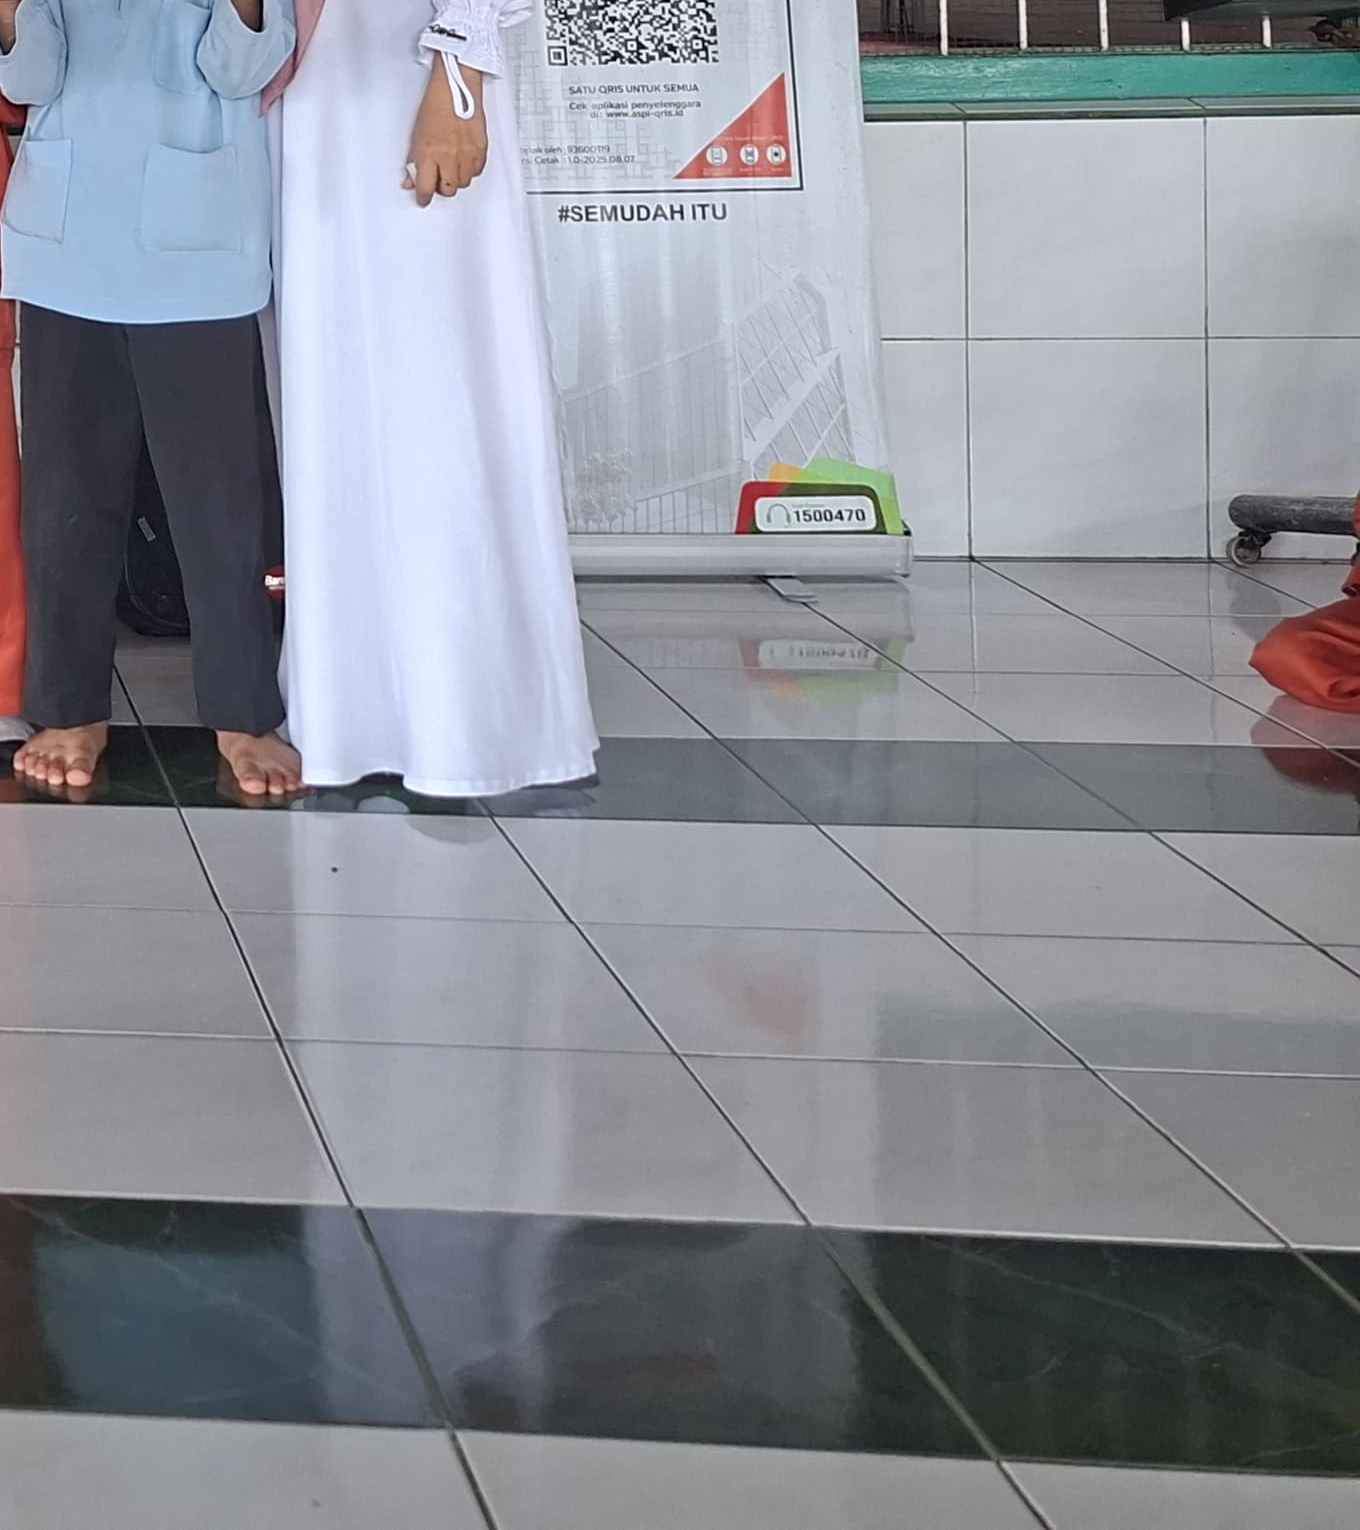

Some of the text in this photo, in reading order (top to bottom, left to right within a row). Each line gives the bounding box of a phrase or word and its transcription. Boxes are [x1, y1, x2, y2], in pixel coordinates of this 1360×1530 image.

[569, 83, 699, 95] SATU QRIS UNTUK SEMUA
[591, 101, 628, 112] aplikasi
[631, 100, 701, 112] penyelenggara
[558, 203, 727, 223] #SEMUDAH ITU
[793, 508, 867, 523] 1500470
